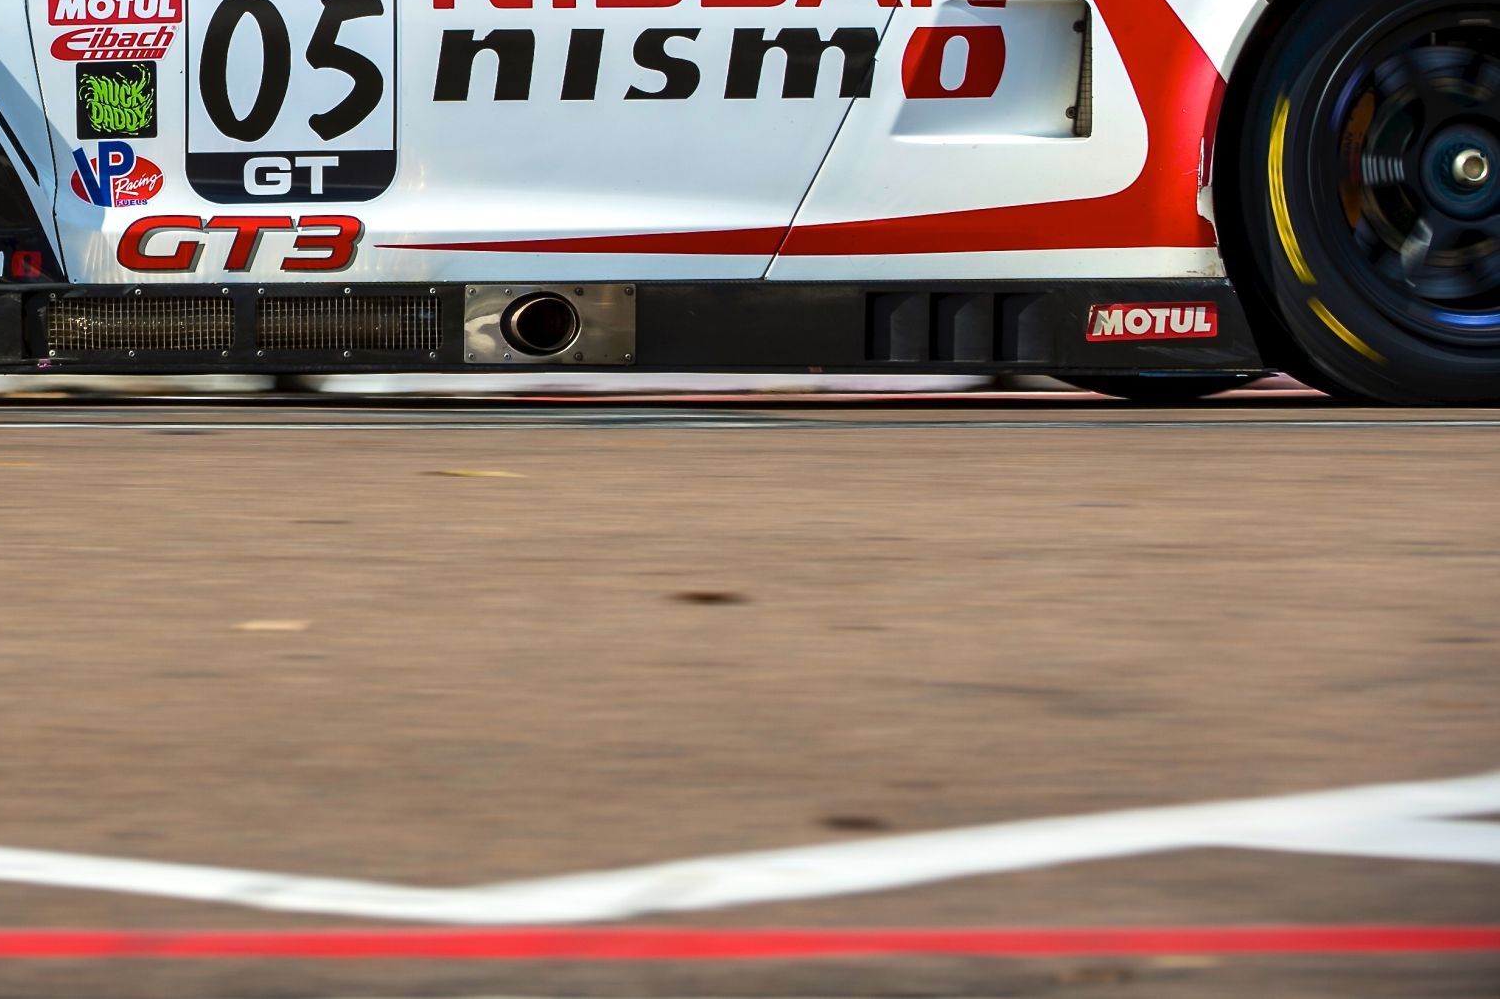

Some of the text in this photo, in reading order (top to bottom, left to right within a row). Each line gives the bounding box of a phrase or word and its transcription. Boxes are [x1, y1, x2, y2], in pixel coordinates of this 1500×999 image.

[51, 26, 174, 60] Eibach
[433, 25, 1006, 101] nismo
[88, 70, 147, 108] MUCK
[91, 102, 150, 131] DADDY
[72, 141, 135, 207] VP
[115, 173, 163, 199] Racing
[243, 156, 340, 196] GT
[116, 214, 366, 273] GT3
[1092, 307, 1212, 336] MOTUL
